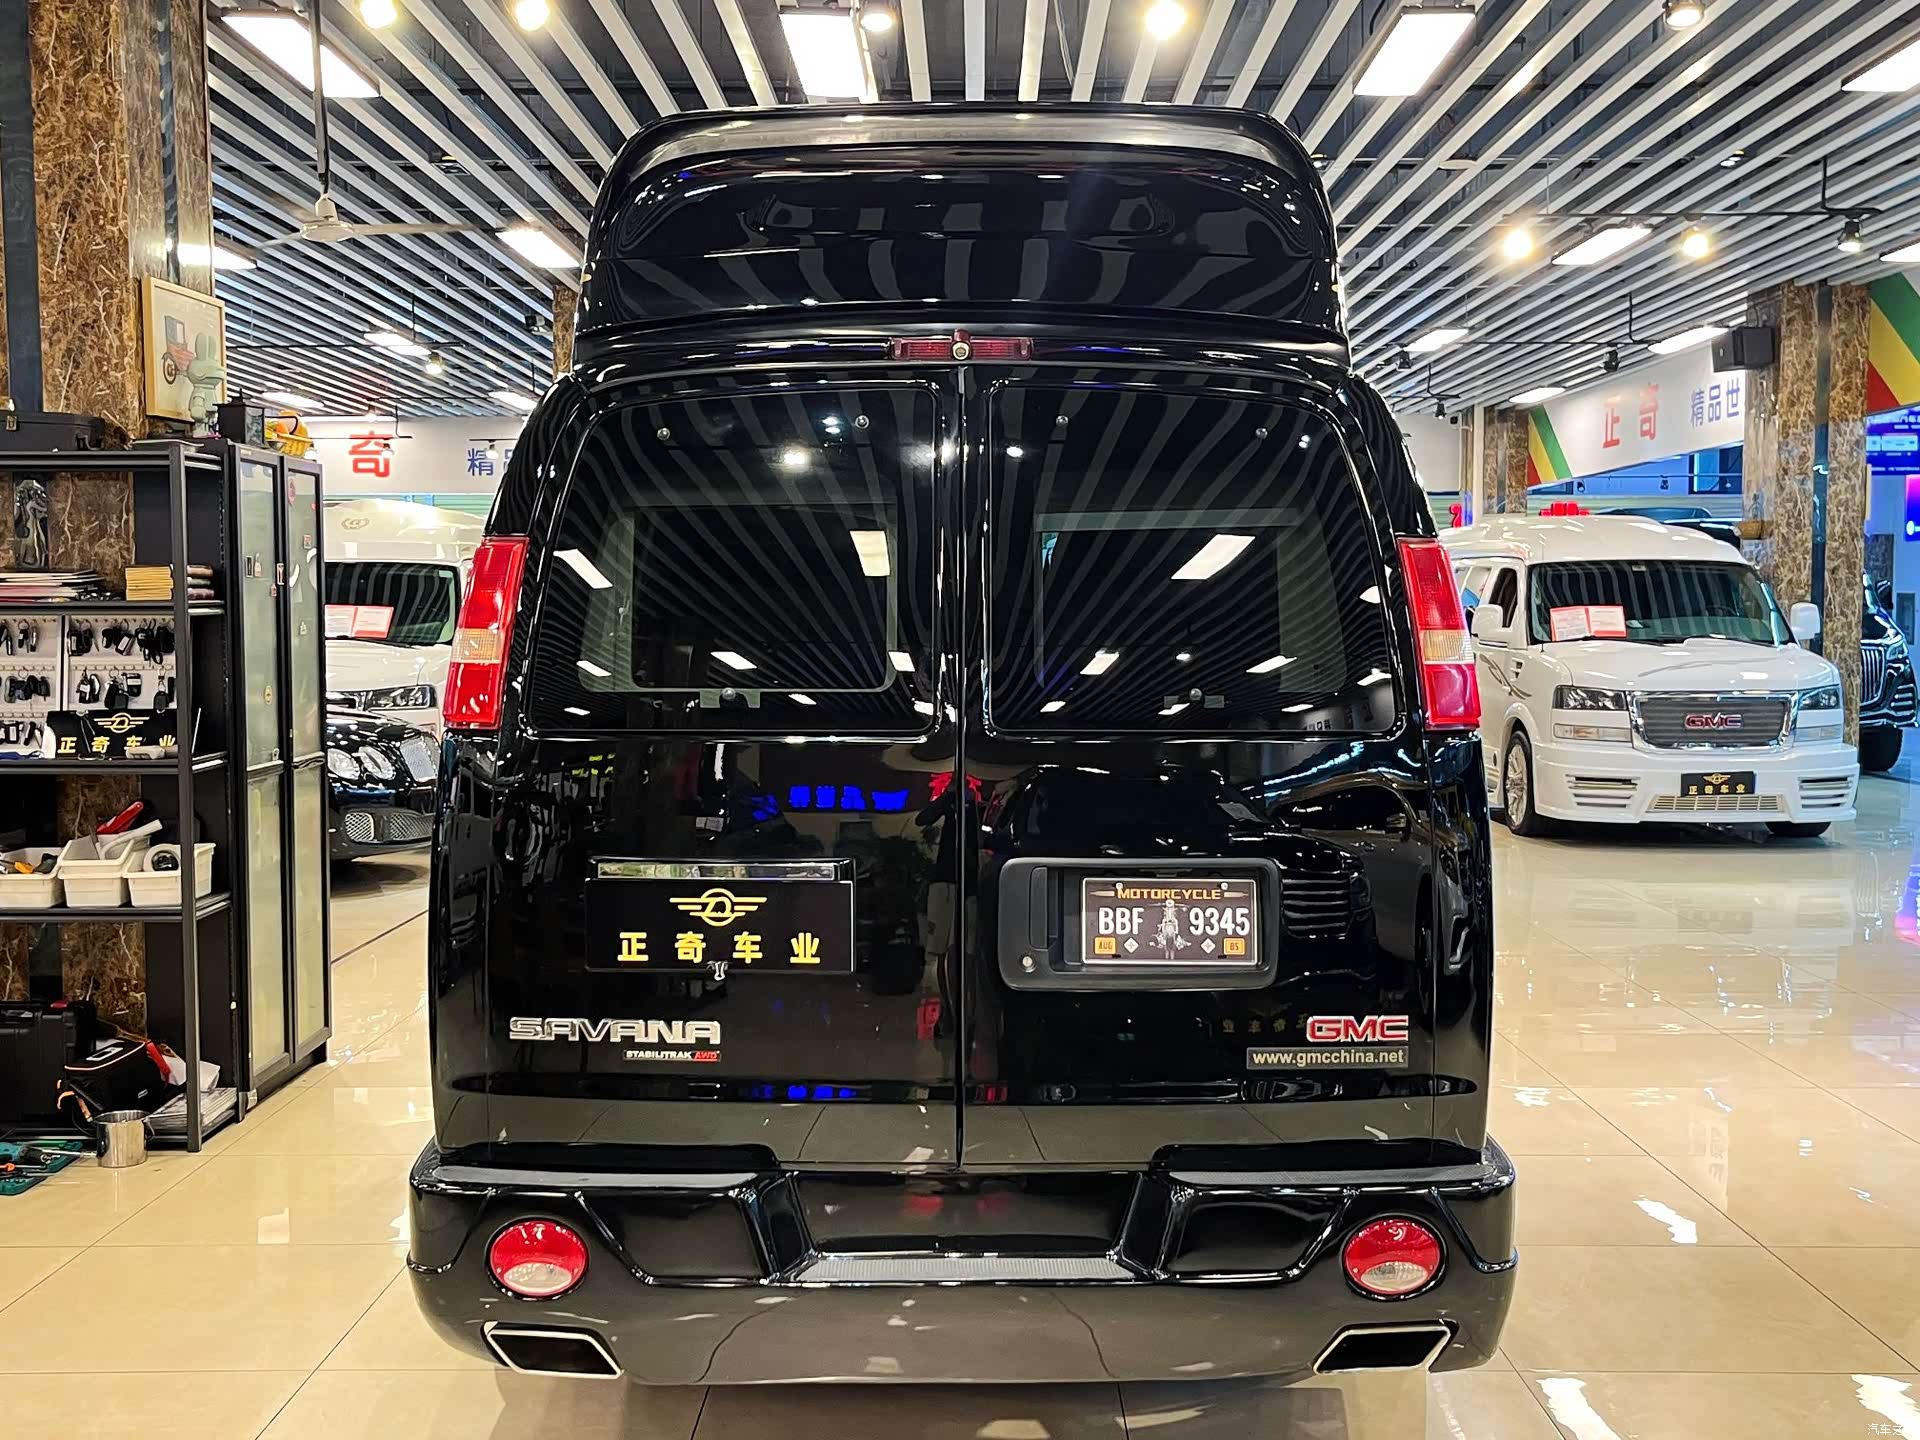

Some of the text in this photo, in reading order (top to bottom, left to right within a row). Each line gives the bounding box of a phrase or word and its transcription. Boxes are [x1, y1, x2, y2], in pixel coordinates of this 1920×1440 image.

[1602, 377, 1740, 449] 正奇 精品世
[348, 431, 394, 478] 奇
[1684, 713, 1743, 730] GMC
[1116, 888, 1222, 900] MOTORCYCLE
[1099, 907, 1250, 936] BBF 9345
[617, 931, 821, 964] 正奇车业
[1098, 942, 1113, 951] AUG
[509, 1016, 721, 1045] SAVANA
[1306, 1015, 1409, 1042] GMC
[626, 1050, 719, 1060] STABILITRAK AWD
[1253, 1050, 1404, 1067] www.gmcchina.net
